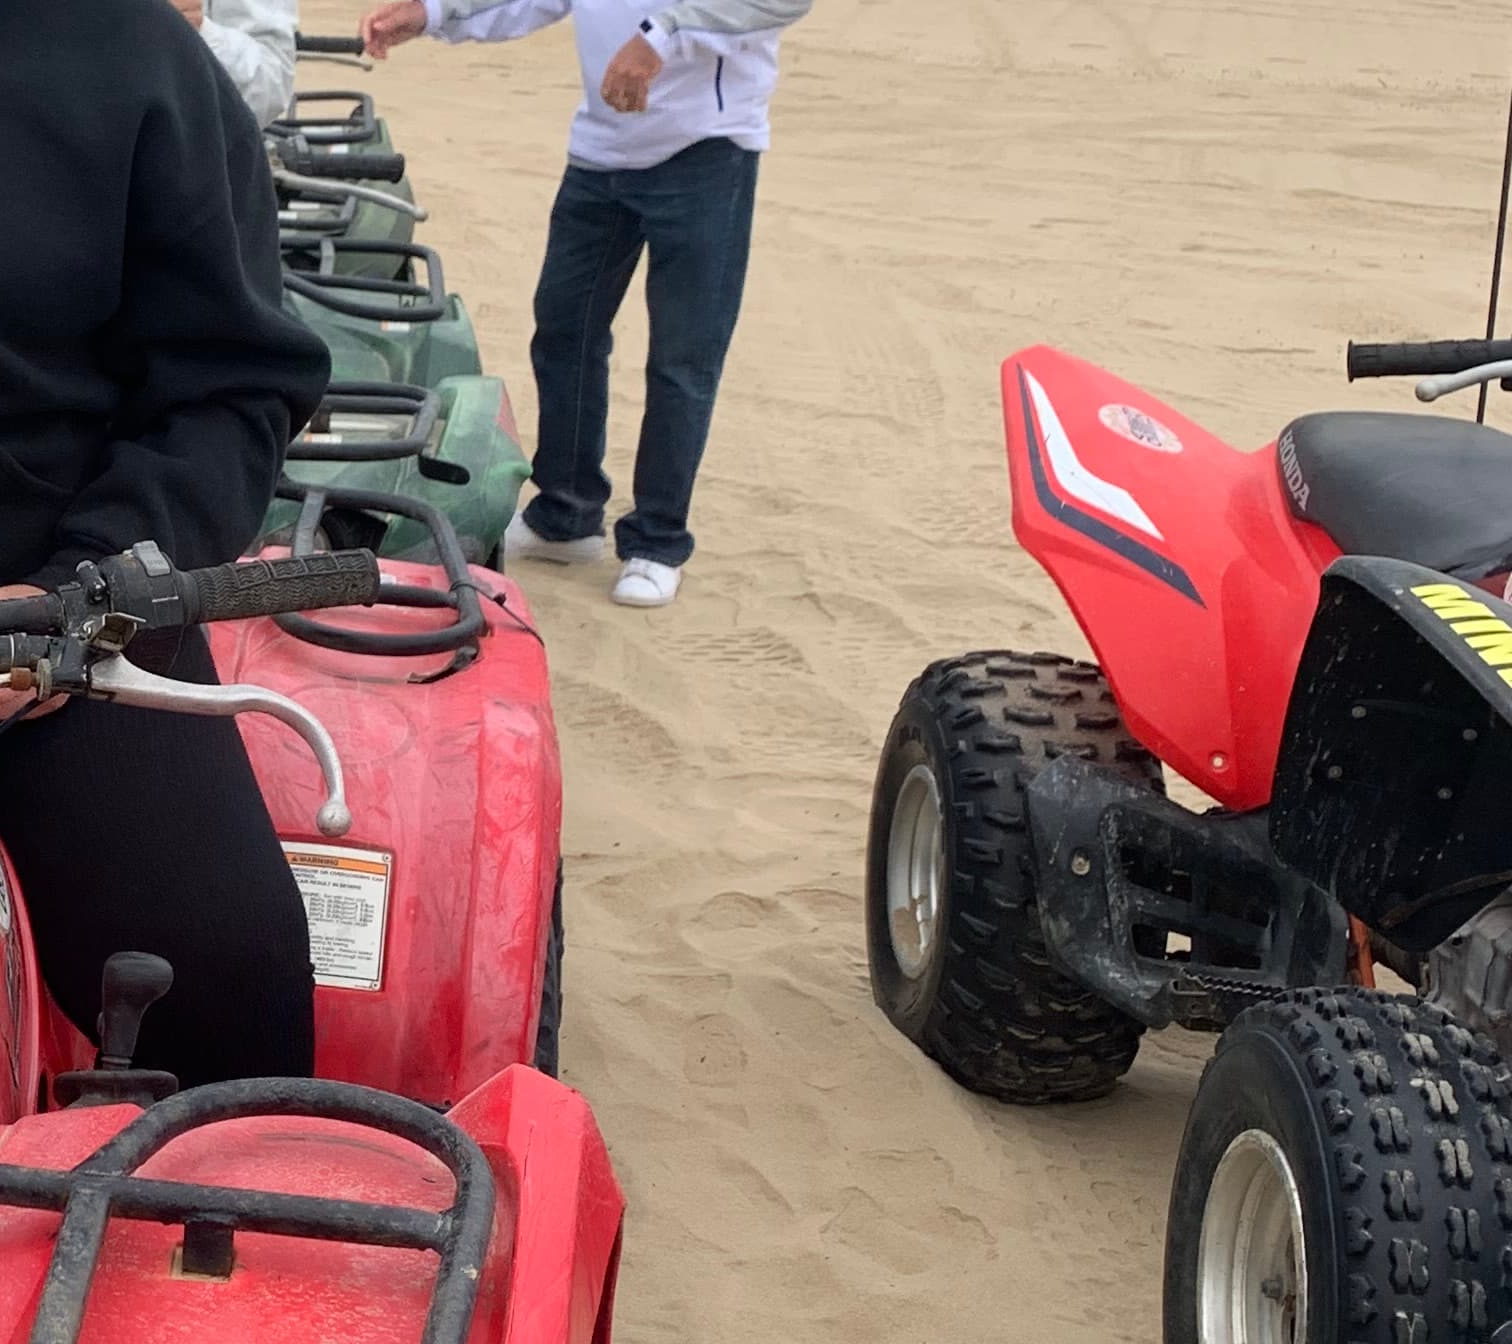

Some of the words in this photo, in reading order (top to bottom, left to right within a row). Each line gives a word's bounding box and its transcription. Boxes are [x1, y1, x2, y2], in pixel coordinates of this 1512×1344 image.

[1279, 429, 1311, 512] HONDA
[1409, 583, 1512, 690] MIN
[299, 855, 340, 866] WARNING
